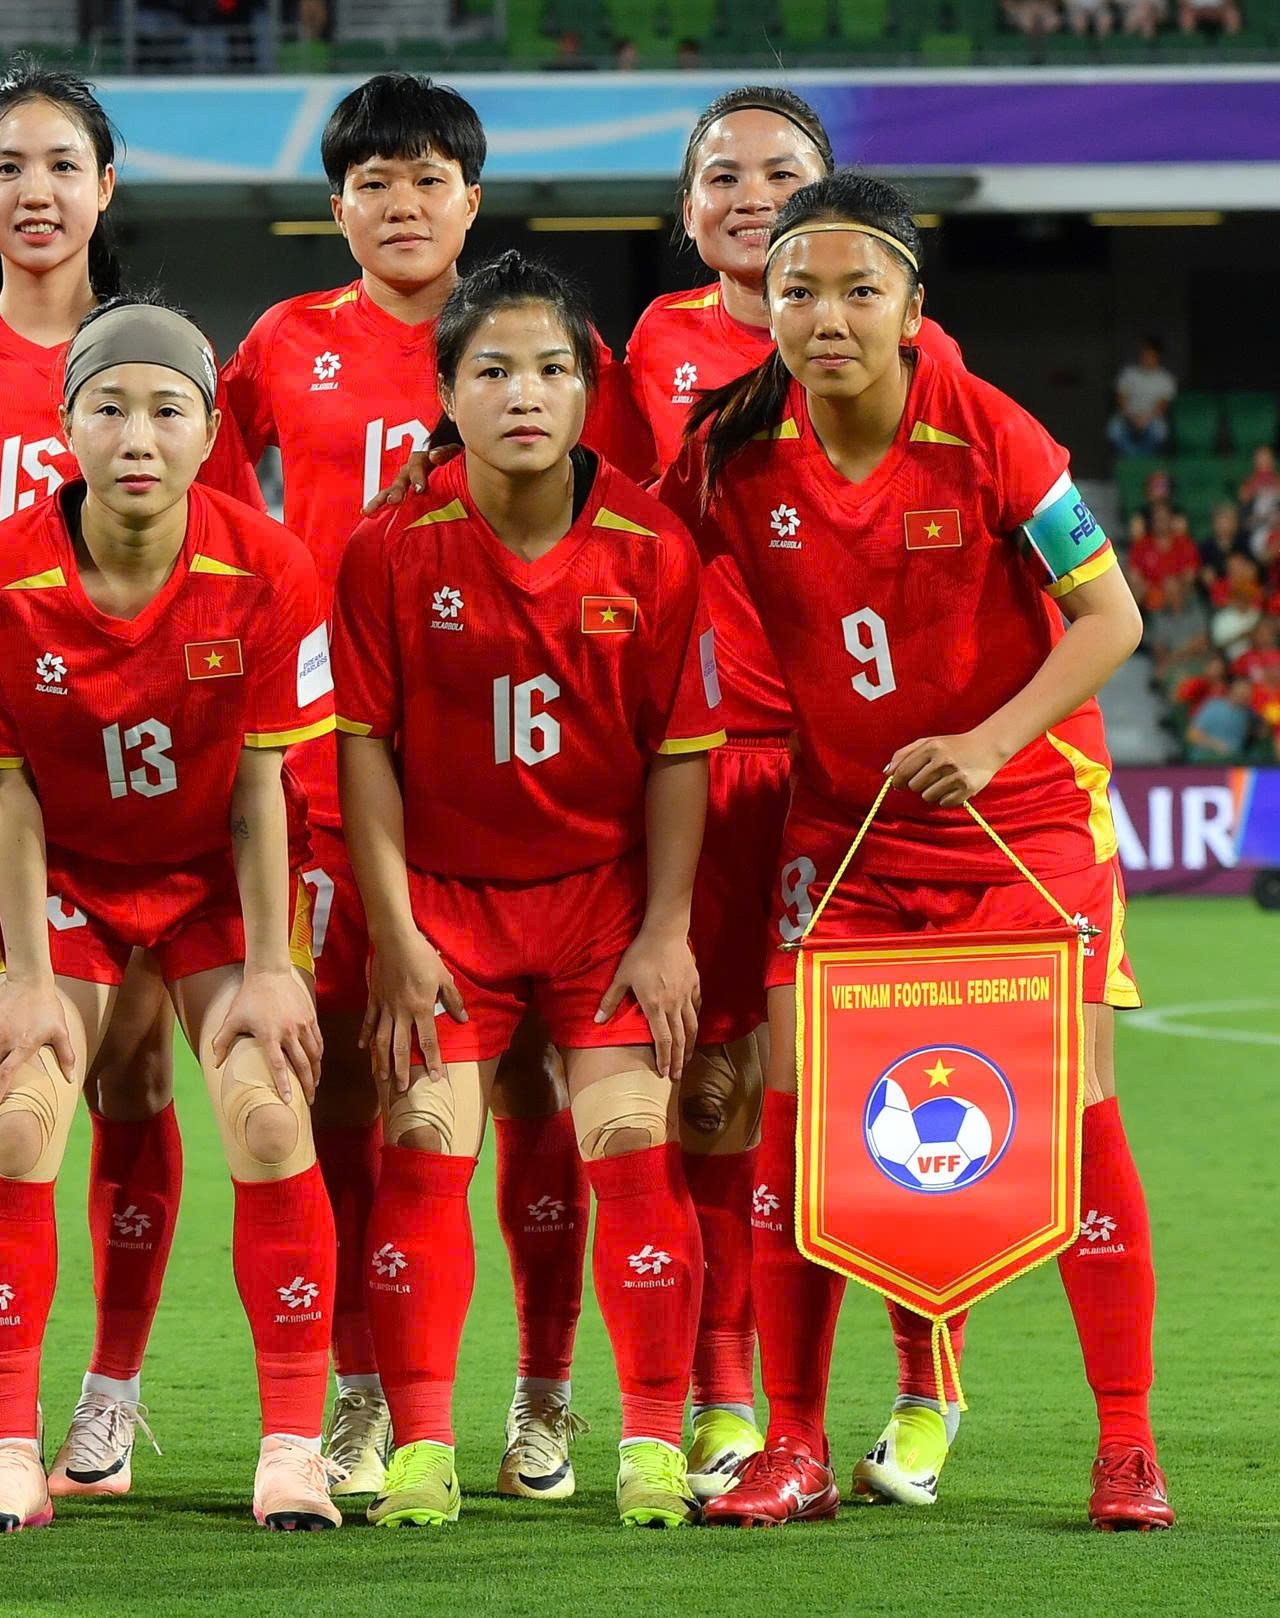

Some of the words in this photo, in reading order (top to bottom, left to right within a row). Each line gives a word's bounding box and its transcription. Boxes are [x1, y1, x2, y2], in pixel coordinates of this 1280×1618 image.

[841, 606, 897, 702] 9
[101, 717, 178, 799] 13
[493, 673, 561, 767] 16
[831, 983, 891, 1009] VIETNAM
[894, 980, 963, 1008] FOOTBALL
[967, 976, 1050, 1005] FEDERATION
[917, 1154, 961, 1174] VFF
